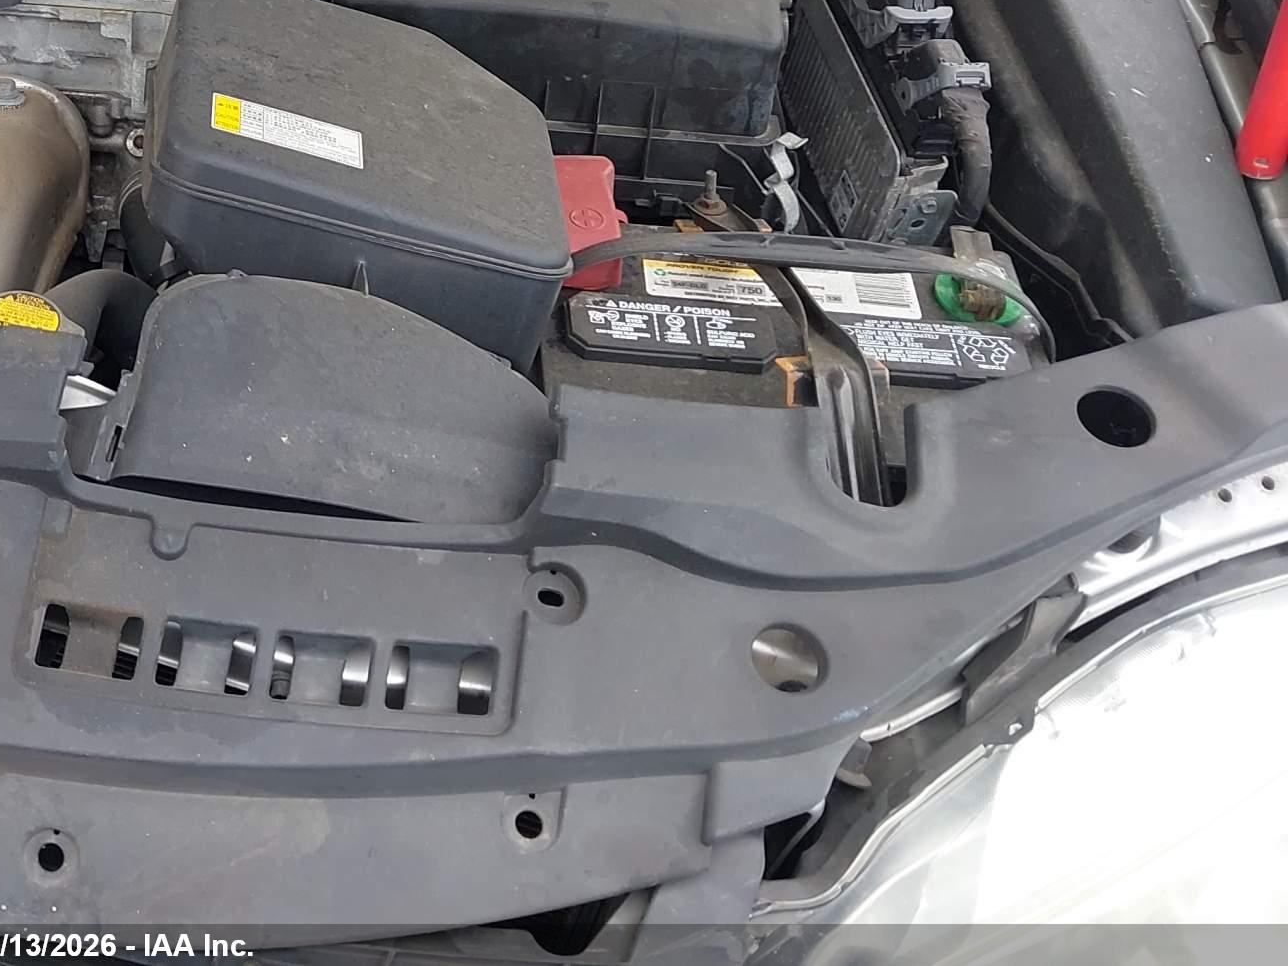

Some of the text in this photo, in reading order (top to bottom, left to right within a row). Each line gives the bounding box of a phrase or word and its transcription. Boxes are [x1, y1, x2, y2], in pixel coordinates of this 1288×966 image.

[741, 286, 763, 295] 750
[618, 300, 731, 317] DANGER / POISON
[855, 328, 877, 336] FLUSH
